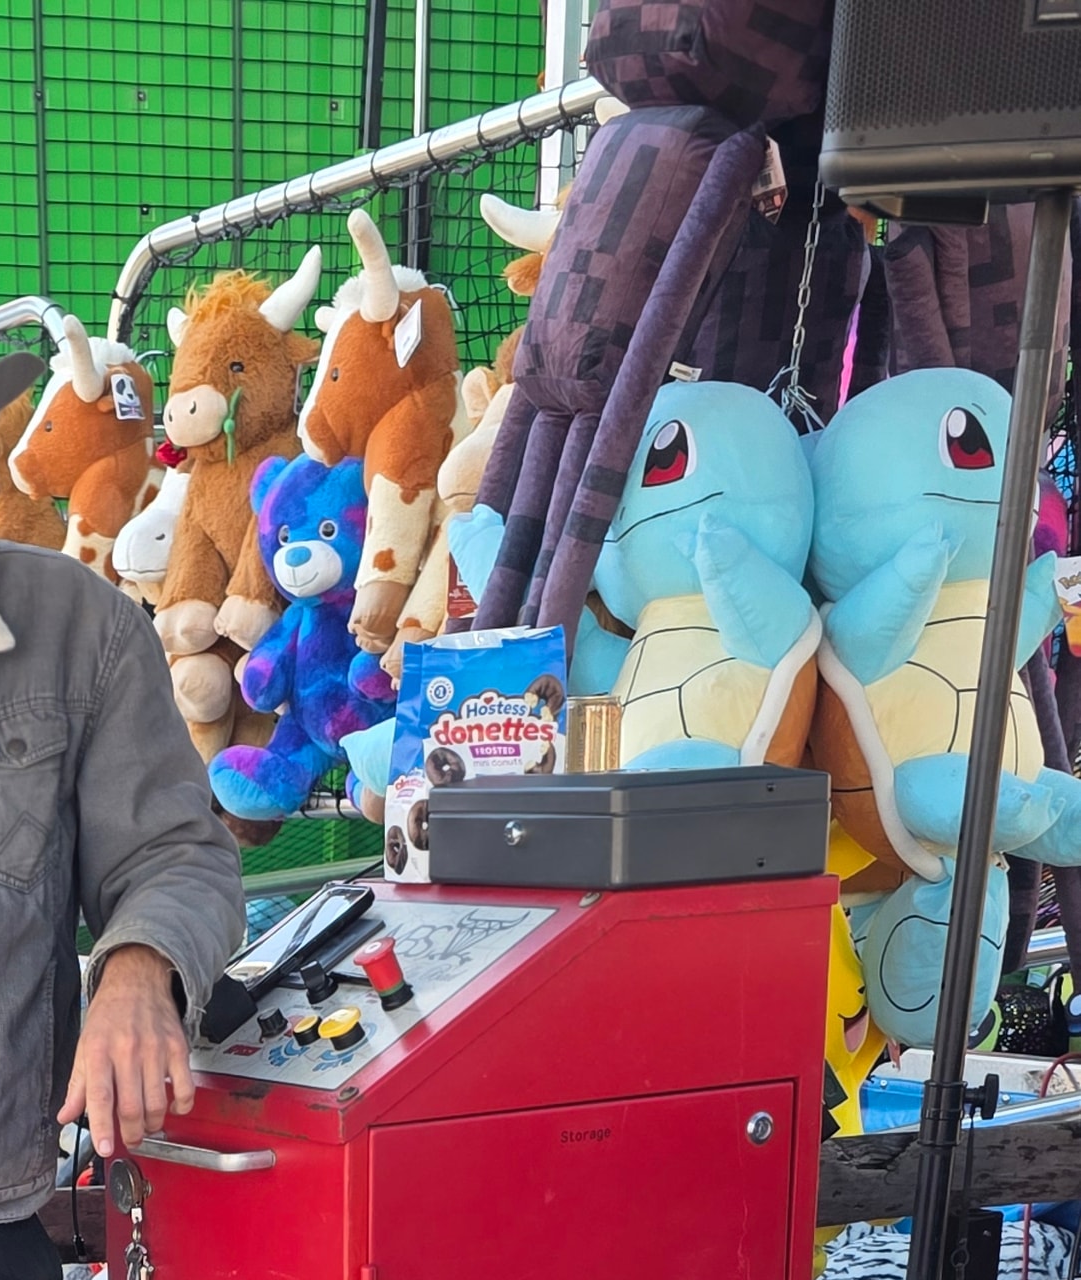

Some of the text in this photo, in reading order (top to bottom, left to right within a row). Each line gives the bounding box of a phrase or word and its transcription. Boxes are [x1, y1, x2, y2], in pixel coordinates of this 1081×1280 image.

[466, 701, 527, 718] Hostess
[434, 717, 555, 746] donettes
[474, 745, 516, 757] FROSTED
[560, 1128, 611, 1144] Storage
